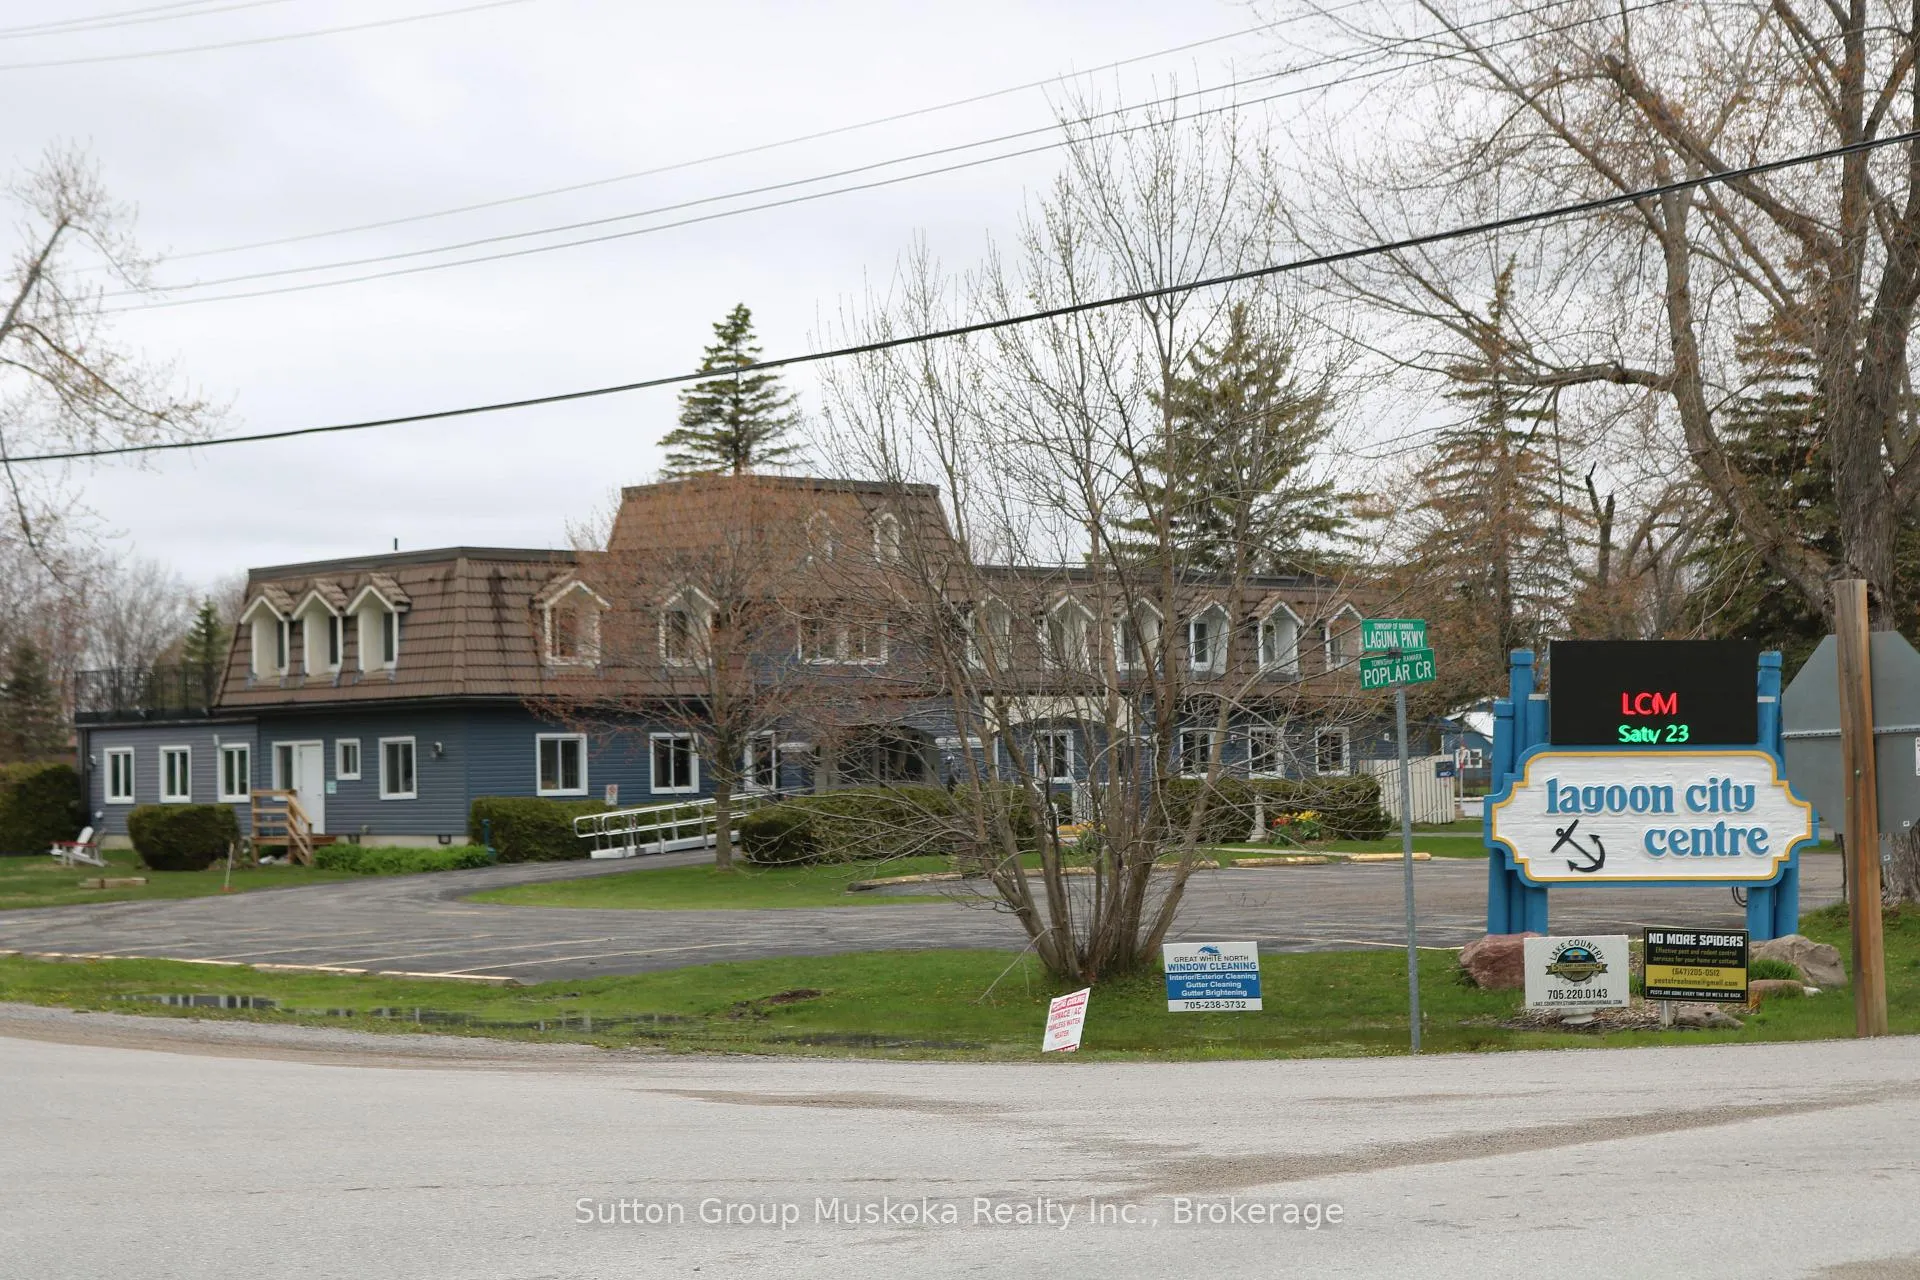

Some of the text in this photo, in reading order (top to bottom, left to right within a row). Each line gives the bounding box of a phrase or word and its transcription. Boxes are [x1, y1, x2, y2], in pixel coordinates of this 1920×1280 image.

[1364, 631, 1424, 649] LAGUNA PKWY
[1364, 661, 1432, 687] POPLAR CR
[1622, 692, 1677, 716] LCM
[1666, 724, 1689, 743] 23
[1546, 777, 1756, 814] lagoon city
[1644, 821, 1769, 857] centre
[1648, 933, 1664, 944] NO
[1666, 933, 1697, 946] MORE
[1550, 939, 1605, 961] LAKE COUNTRY
[1168, 962, 1257, 971] WINDOW CLEANING
[1548, 989, 1608, 1000] 705.220.0143
[1184, 1001, 1247, 1009] 705-238-3732
